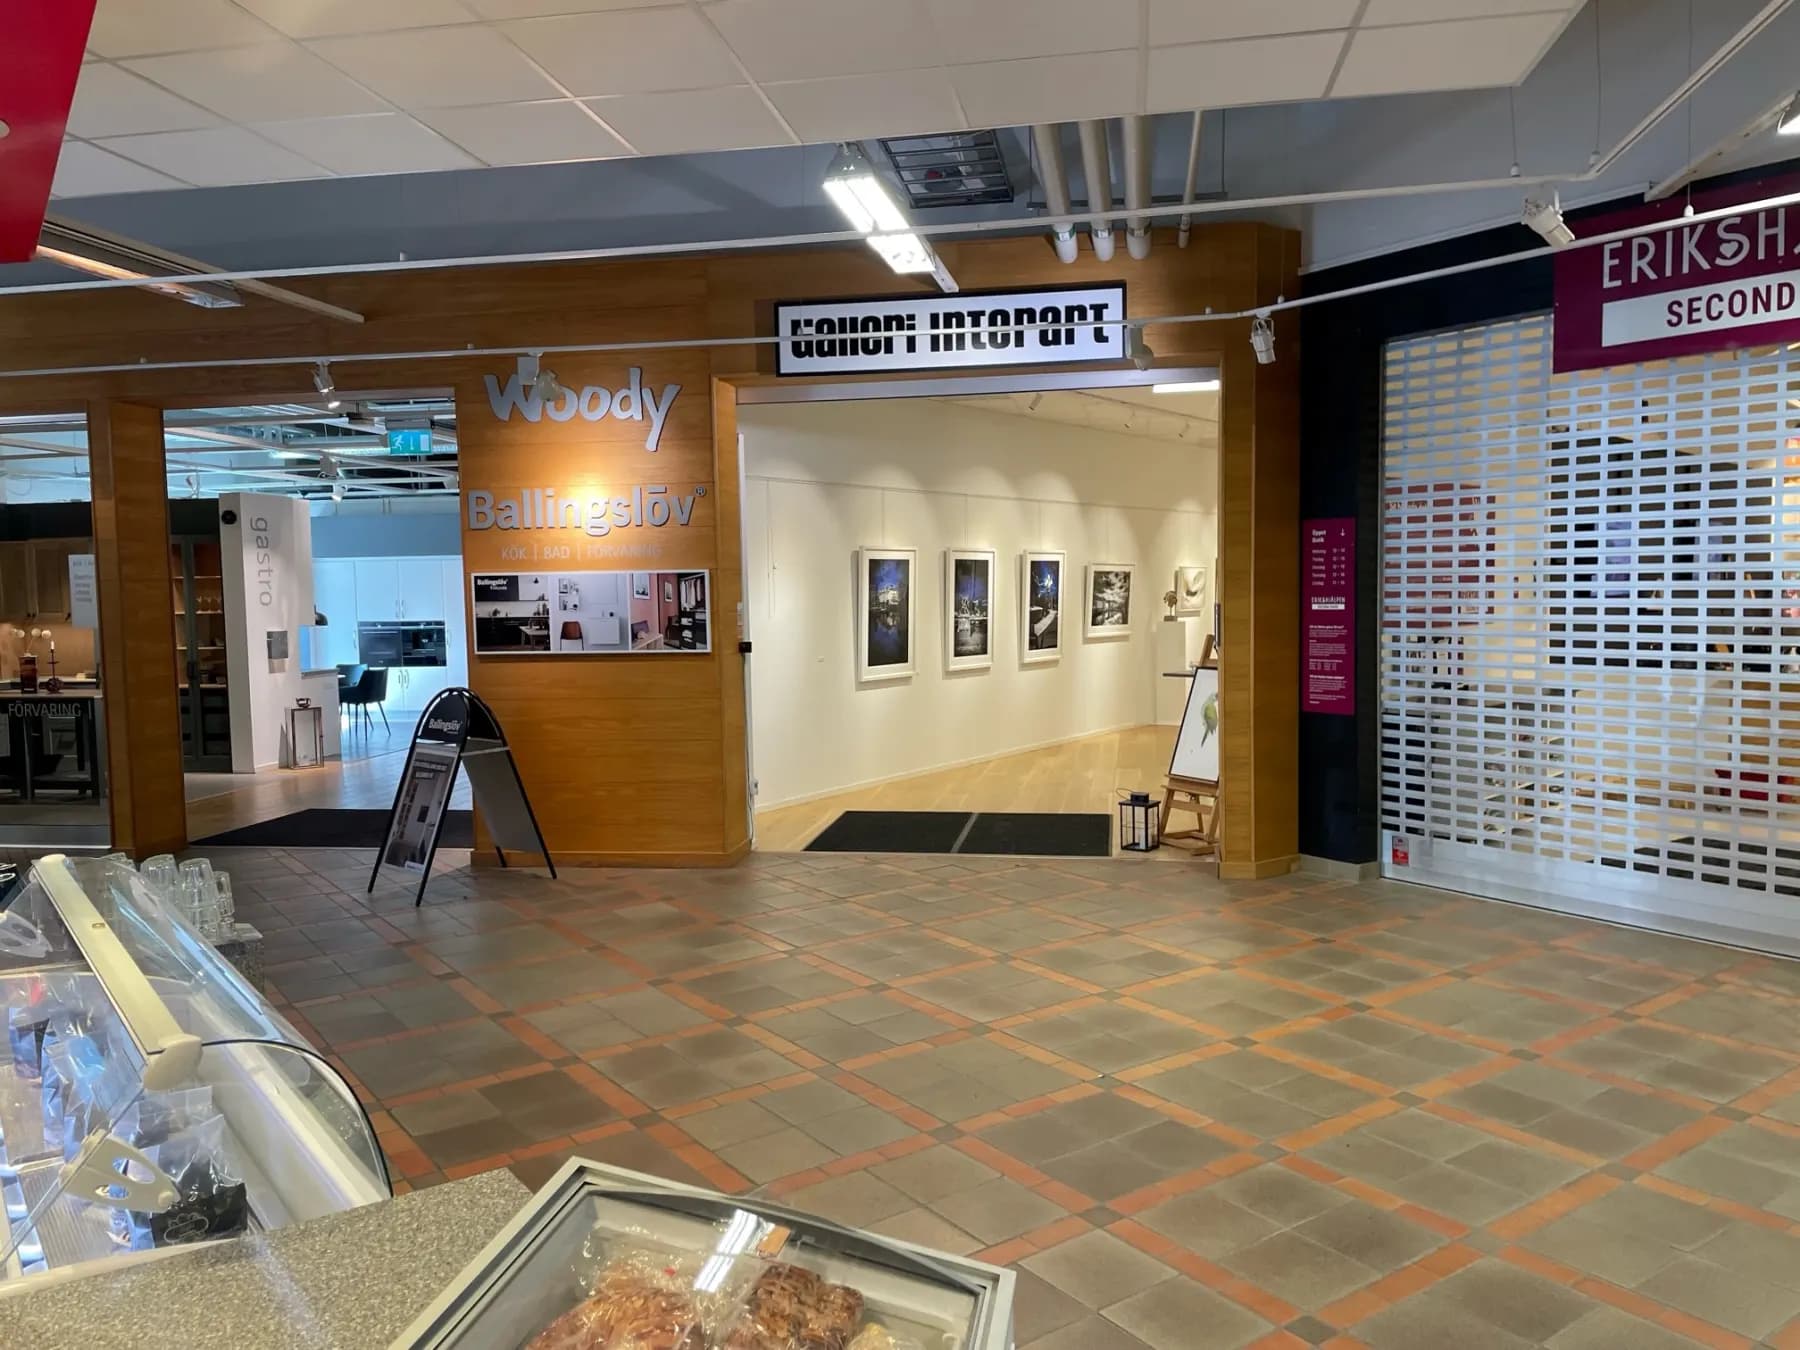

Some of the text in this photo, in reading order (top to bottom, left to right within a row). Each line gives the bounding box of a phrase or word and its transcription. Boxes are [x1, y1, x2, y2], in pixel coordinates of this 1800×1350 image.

[1602, 207, 1800, 289] ERIKSH
[930, 302, 1109, 353] Interart
[1666, 281, 1796, 328] SECOND
[483, 366, 682, 452] Woody
[249, 516, 274, 607] gastro
[543, 545, 570, 560] BAD
